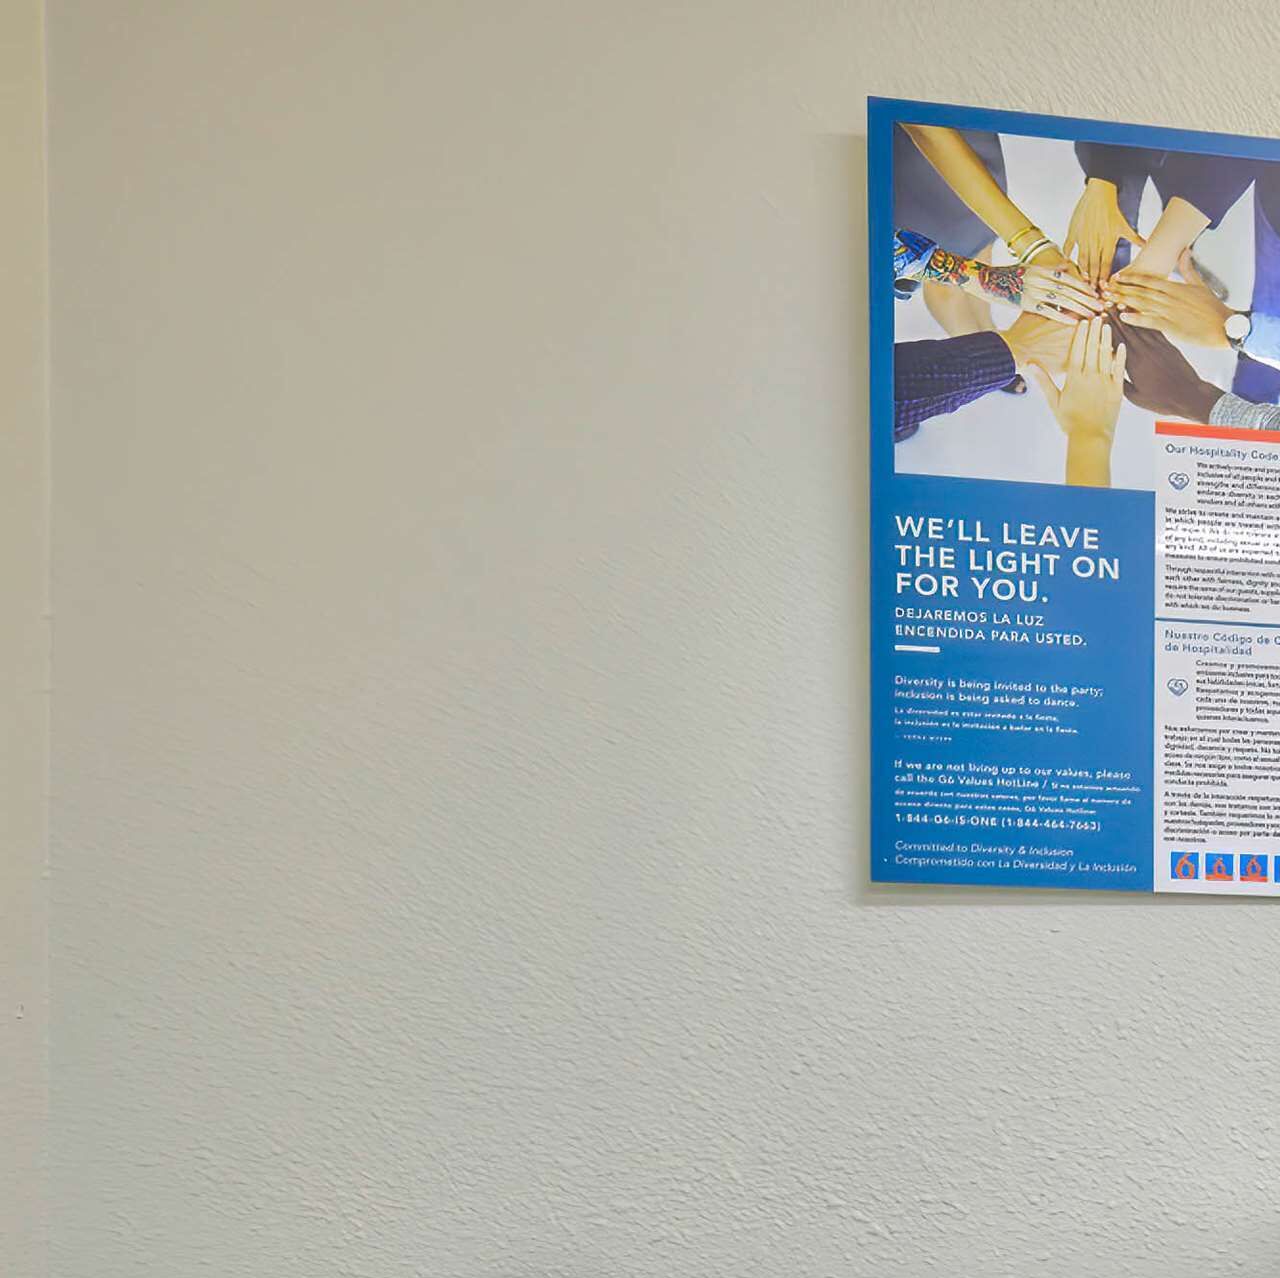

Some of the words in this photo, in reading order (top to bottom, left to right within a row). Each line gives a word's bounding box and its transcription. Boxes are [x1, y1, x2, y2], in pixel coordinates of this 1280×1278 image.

[1165, 443, 1185, 453] Our
[1189, 445, 1247, 460] Hospitality
[1250, 449, 1278, 460] Code
[1002, 522, 1098, 549] LEAVE
[894, 544, 955, 569] THE
[969, 549, 1060, 576] LIGHT
[1071, 555, 1119, 580] ON
[895, 572, 959, 598] FOR
[970, 576, 1048, 603] YOU.
[894, 606, 987, 623] DEJAREMOS
[992, 612, 1011, 624] LA
[1016, 613, 1044, 626] LUZ
[894, 624, 985, 640] ENCENDIDA
[991, 629, 1029, 643] PARA
[1035, 632, 1086, 646] USTED.
[1164, 629, 1208, 641] Nuestro
[1212, 632, 1252, 645] Código
[1256, 634, 1270, 644] de
[1164, 642, 1178, 651] de
[1181, 643, 1252, 658] Hospitalidad
[894, 675, 943, 689] Diversity
[947, 678, 956, 687] is
[959, 679, 990, 691] being
[993, 681, 1031, 692] invited
[1035, 683, 1046, 692] to
[1050, 684, 1067, 694] the
[1071, 686, 1103, 697] party;
[894, 689, 942, 700] inclusion
[946, 691, 955, 701] is
[958, 692, 989, 704] being
[993, 694, 1025, 705] asked
[1028, 695, 1040, 705] to
[1043, 696, 1079, 707] dance.
[893, 759, 900, 768] If
[925, 762, 942, 770] are
[946, 762, 964, 771] not
[968, 763, 998, 775] living
[1001, 766, 1014, 775] up
[1019, 766, 1031, 774] to
[1033, 768, 1052, 776] our
[1055, 767, 1091, 778] values,
[1095, 769, 1131, 781] please
[893, 773, 913, 783] call
[916, 774, 934, 784] the
[938, 775, 954, 784] G6
[957, 776, 992, 786] Values
[894, 840, 956, 852] Committed
[957, 843, 967, 852] to
[971, 843, 1015, 856] Diversity
[1017, 846, 1025, 854] &
[1028, 845, 1073, 856] Inclusion
[894, 854, 978, 868] Comprometido
[998, 858, 1010, 868] La
[1012, 858, 1066, 870] Diversidad
[1078, 861, 1089, 870] La
